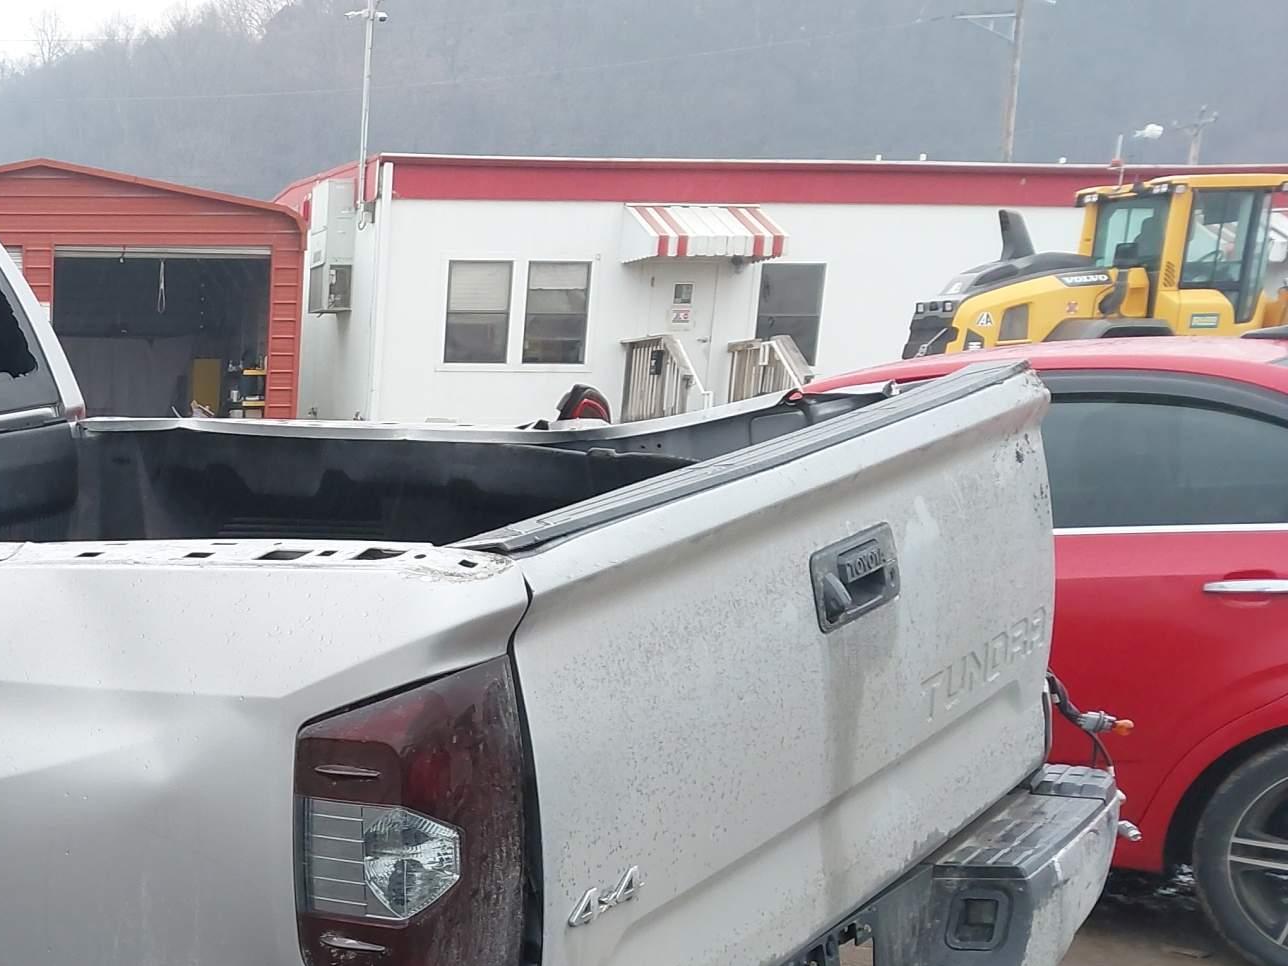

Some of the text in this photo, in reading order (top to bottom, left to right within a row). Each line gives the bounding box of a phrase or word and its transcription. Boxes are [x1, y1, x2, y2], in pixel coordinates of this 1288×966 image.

[1062, 274, 1109, 284] VOLVO
[920, 606, 1046, 721] TUNDRA
[567, 865, 645, 928] 4x4
